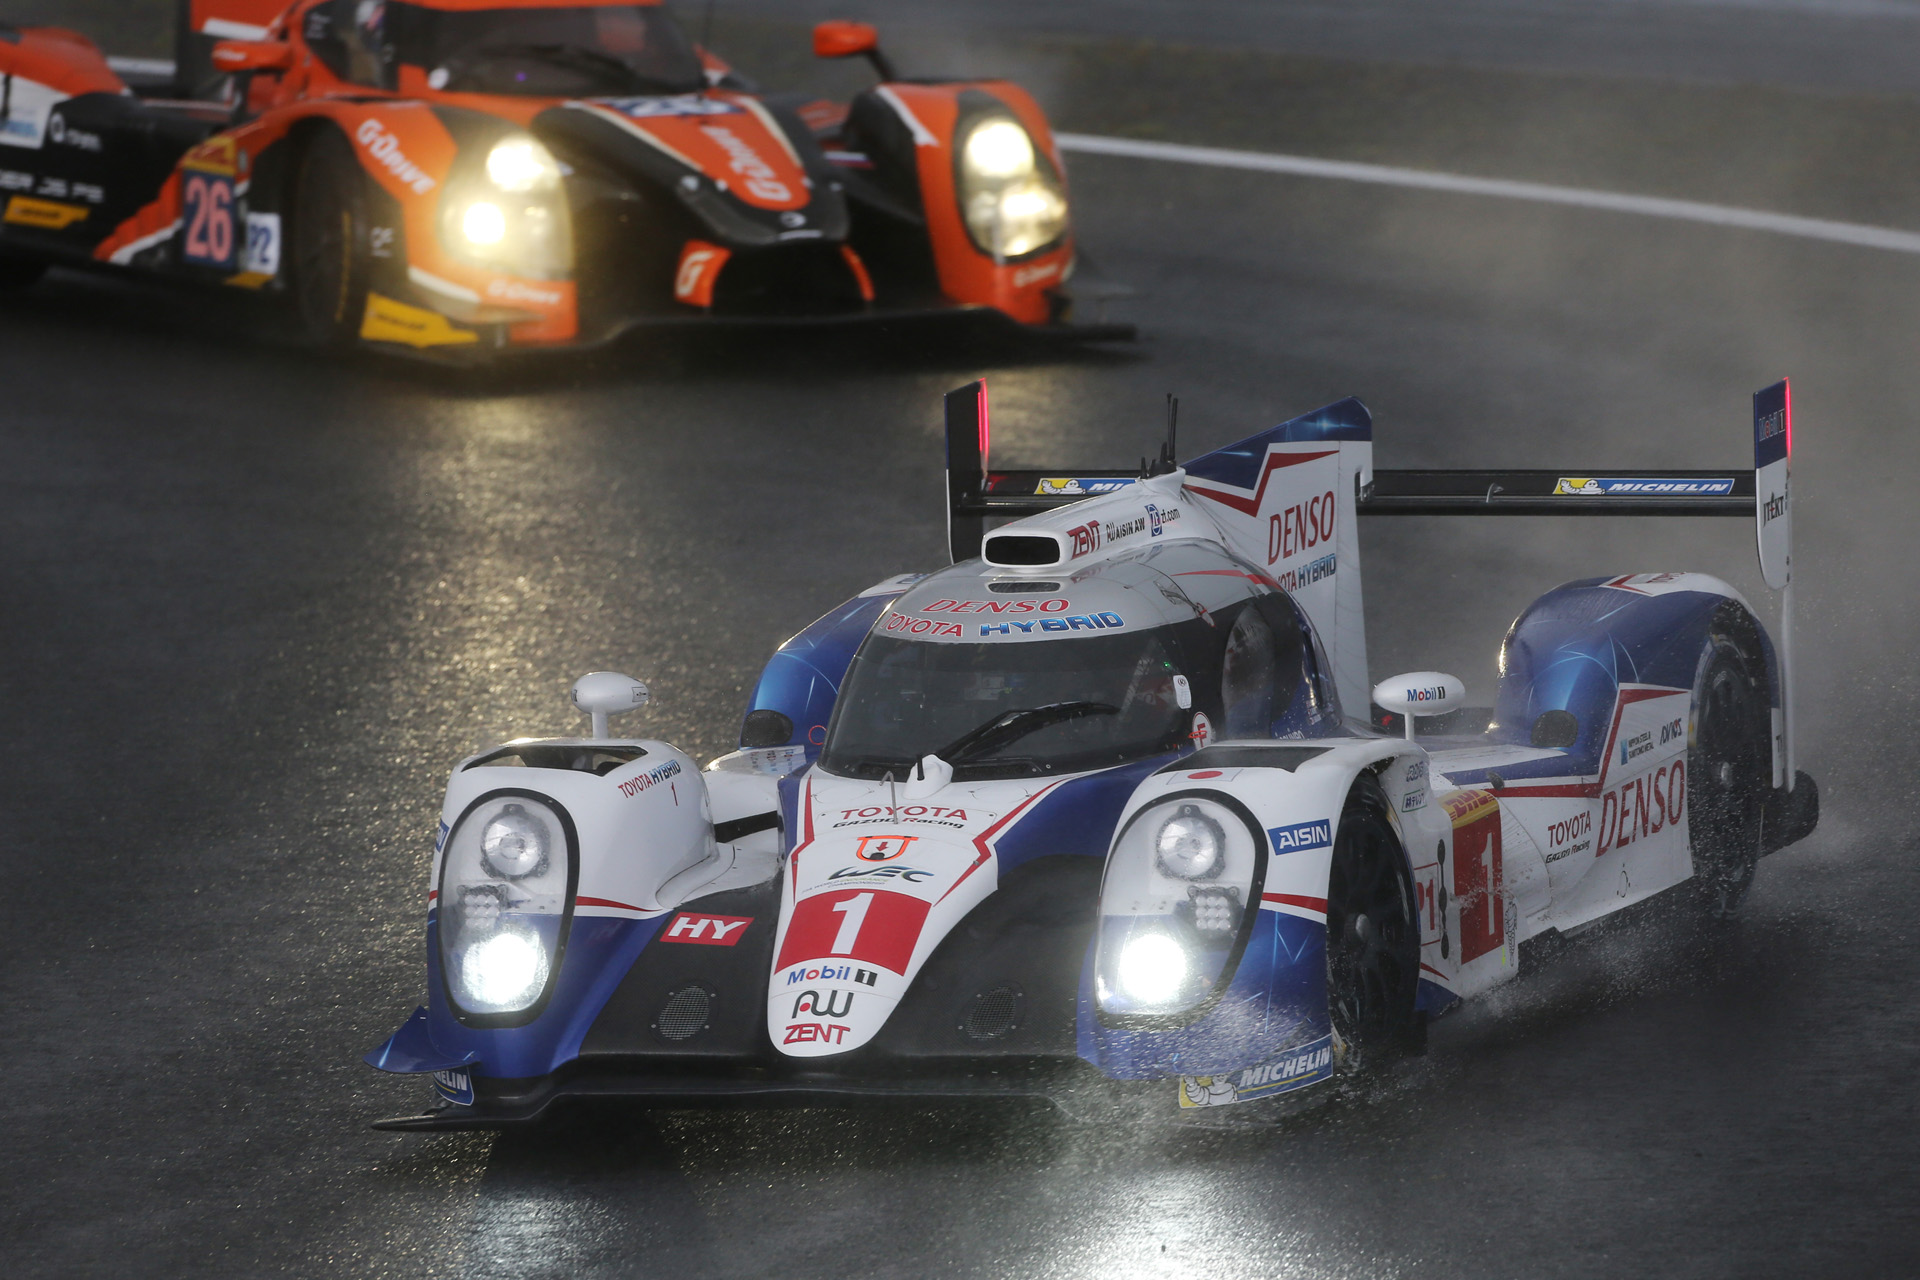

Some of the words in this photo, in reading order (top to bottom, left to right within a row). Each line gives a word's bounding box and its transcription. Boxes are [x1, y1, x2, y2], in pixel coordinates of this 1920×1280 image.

[187, 177, 232, 262] 26
[1608, 483, 1729, 492] MICHELIN
[1066, 520, 1100, 560] ZENT
[1116, 521, 1133, 540] AISIN
[1134, 517, 1145, 534] AW
[1161, 509, 1180, 523] zf.com
[1268, 491, 1334, 566] DENSO
[1298, 553, 1336, 588] HYBRID
[921, 599, 1069, 613] DENSO
[881, 612, 963, 637] TOYOTA
[979, 611, 1125, 637] HYBRID
[1407, 687, 1436, 701] Mobil
[618, 773, 653, 799] TOYOTA
[648, 759, 682, 785] HYBRID
[841, 806, 968, 821] TOYOTA
[902, 817, 965, 829] Racing
[1596, 759, 1685, 857] DENSO
[1279, 825, 1329, 850] AISIN
[1547, 810, 1591, 848] TOYOTA
[1481, 831, 1495, 936] 1
[667, 917, 747, 940] HY
[830, 892, 874, 955] 1
[787, 966, 850, 985] Mobil
[783, 1023, 850, 1045] ZENT
[1239, 1046, 1331, 1088] MICHELIN
